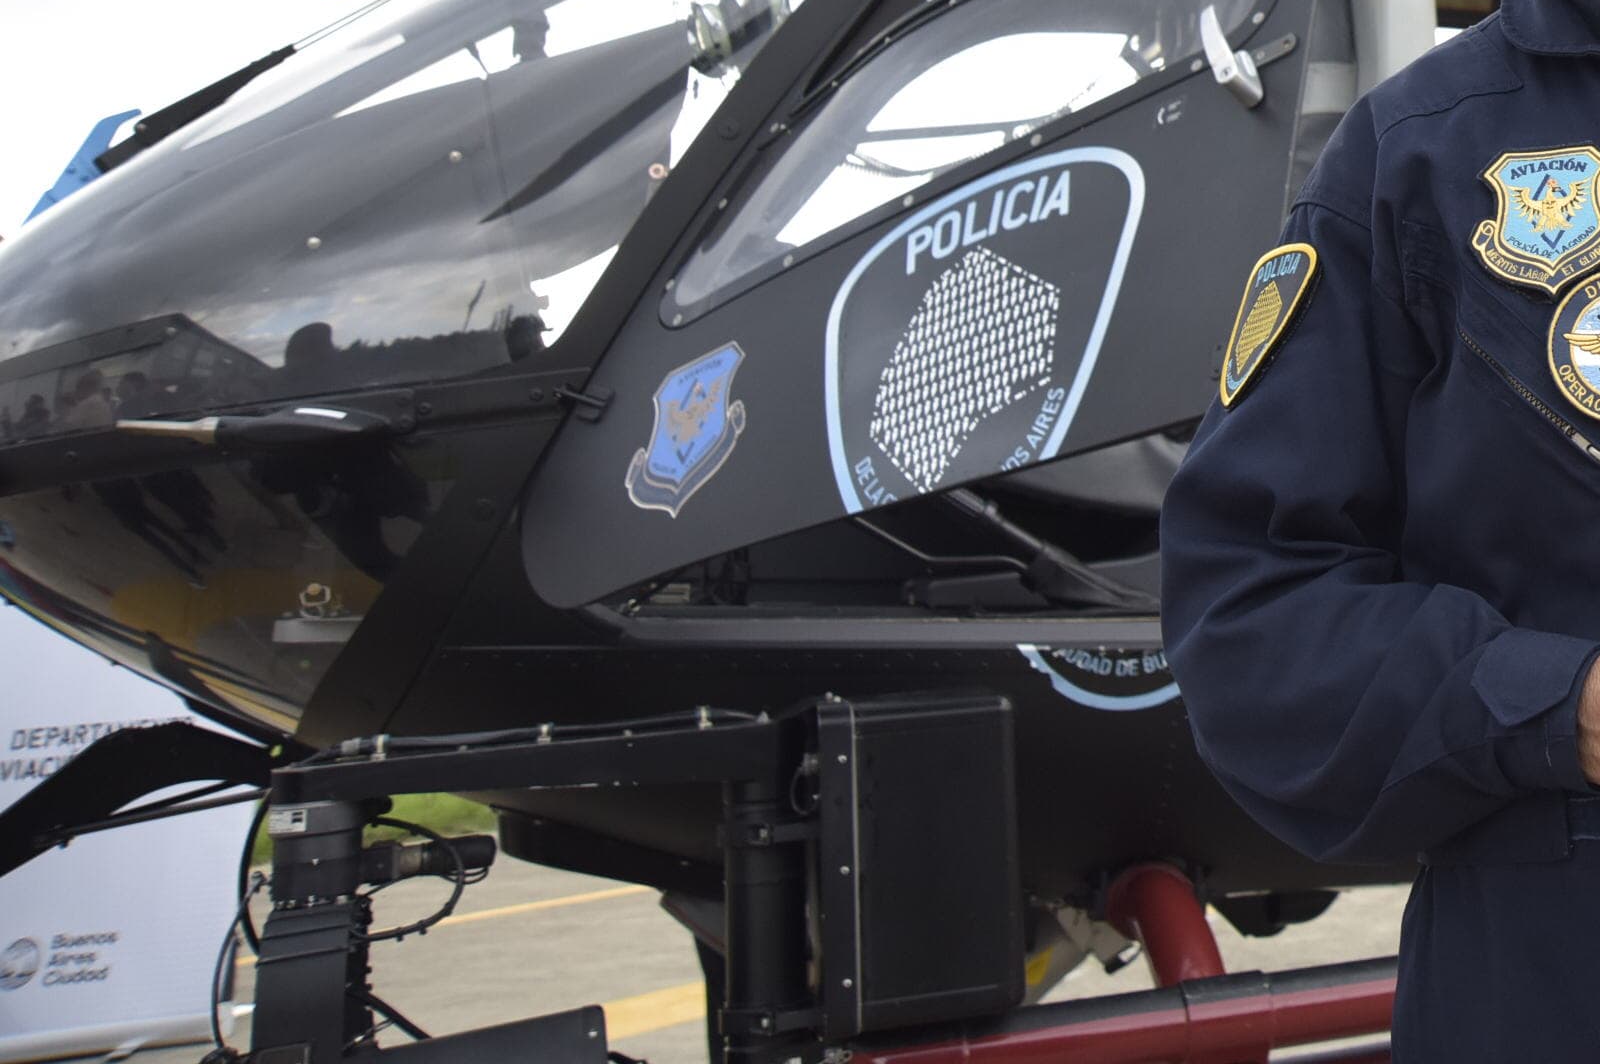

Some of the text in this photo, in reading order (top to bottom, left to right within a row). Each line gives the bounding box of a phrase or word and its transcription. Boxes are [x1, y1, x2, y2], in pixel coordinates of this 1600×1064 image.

[1510, 157, 1588, 181] AVIACIÓN
[905, 170, 1071, 275] POLICIA
[1255, 253, 1302, 288] POLICIA
[1561, 263, 1575, 276] ET
[1026, 385, 1066, 450] AIRES
[1114, 658, 1140, 677] DE
